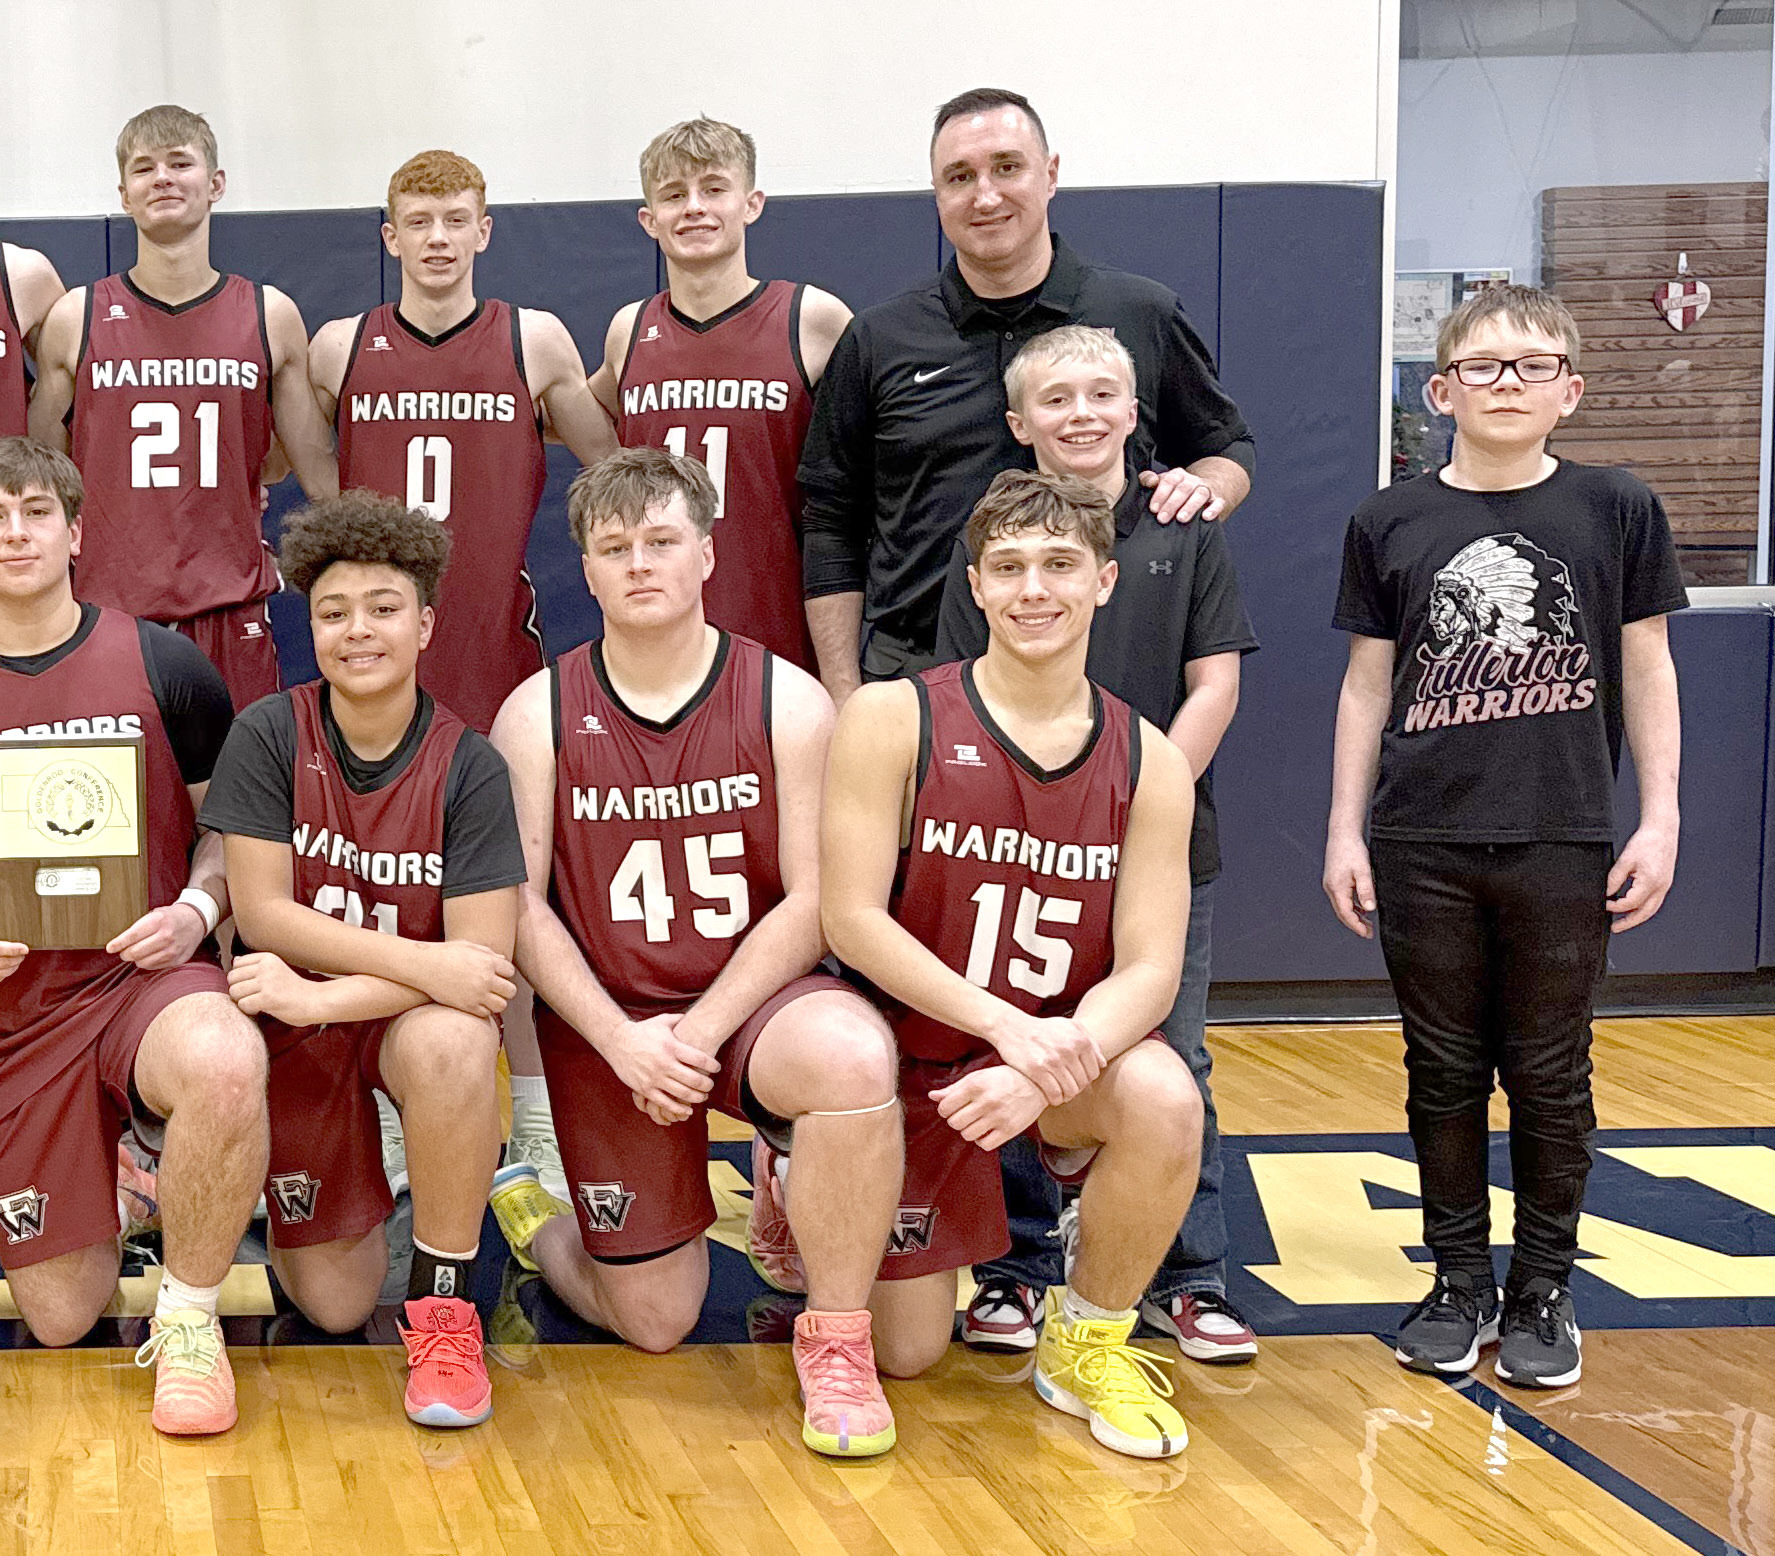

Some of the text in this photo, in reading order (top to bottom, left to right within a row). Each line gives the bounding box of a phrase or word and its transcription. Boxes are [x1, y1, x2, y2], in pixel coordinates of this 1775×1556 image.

[91, 358, 259, 390] WARRIORS
[624, 379, 790, 416] WARRIORS
[351, 392, 516, 422] WARRIORS
[131, 402, 220, 488] 21
[406, 436, 453, 522] 0
[1416, 637, 1588, 701] Fullerton
[1404, 679, 1597, 733] WARRIORS
[572, 772, 760, 821] WARRIORS
[292, 820, 443, 886] WARRIORS
[921, 818, 1119, 880] WARRIOR
[609, 831, 750, 942] 45
[965, 882, 1083, 999] 15
